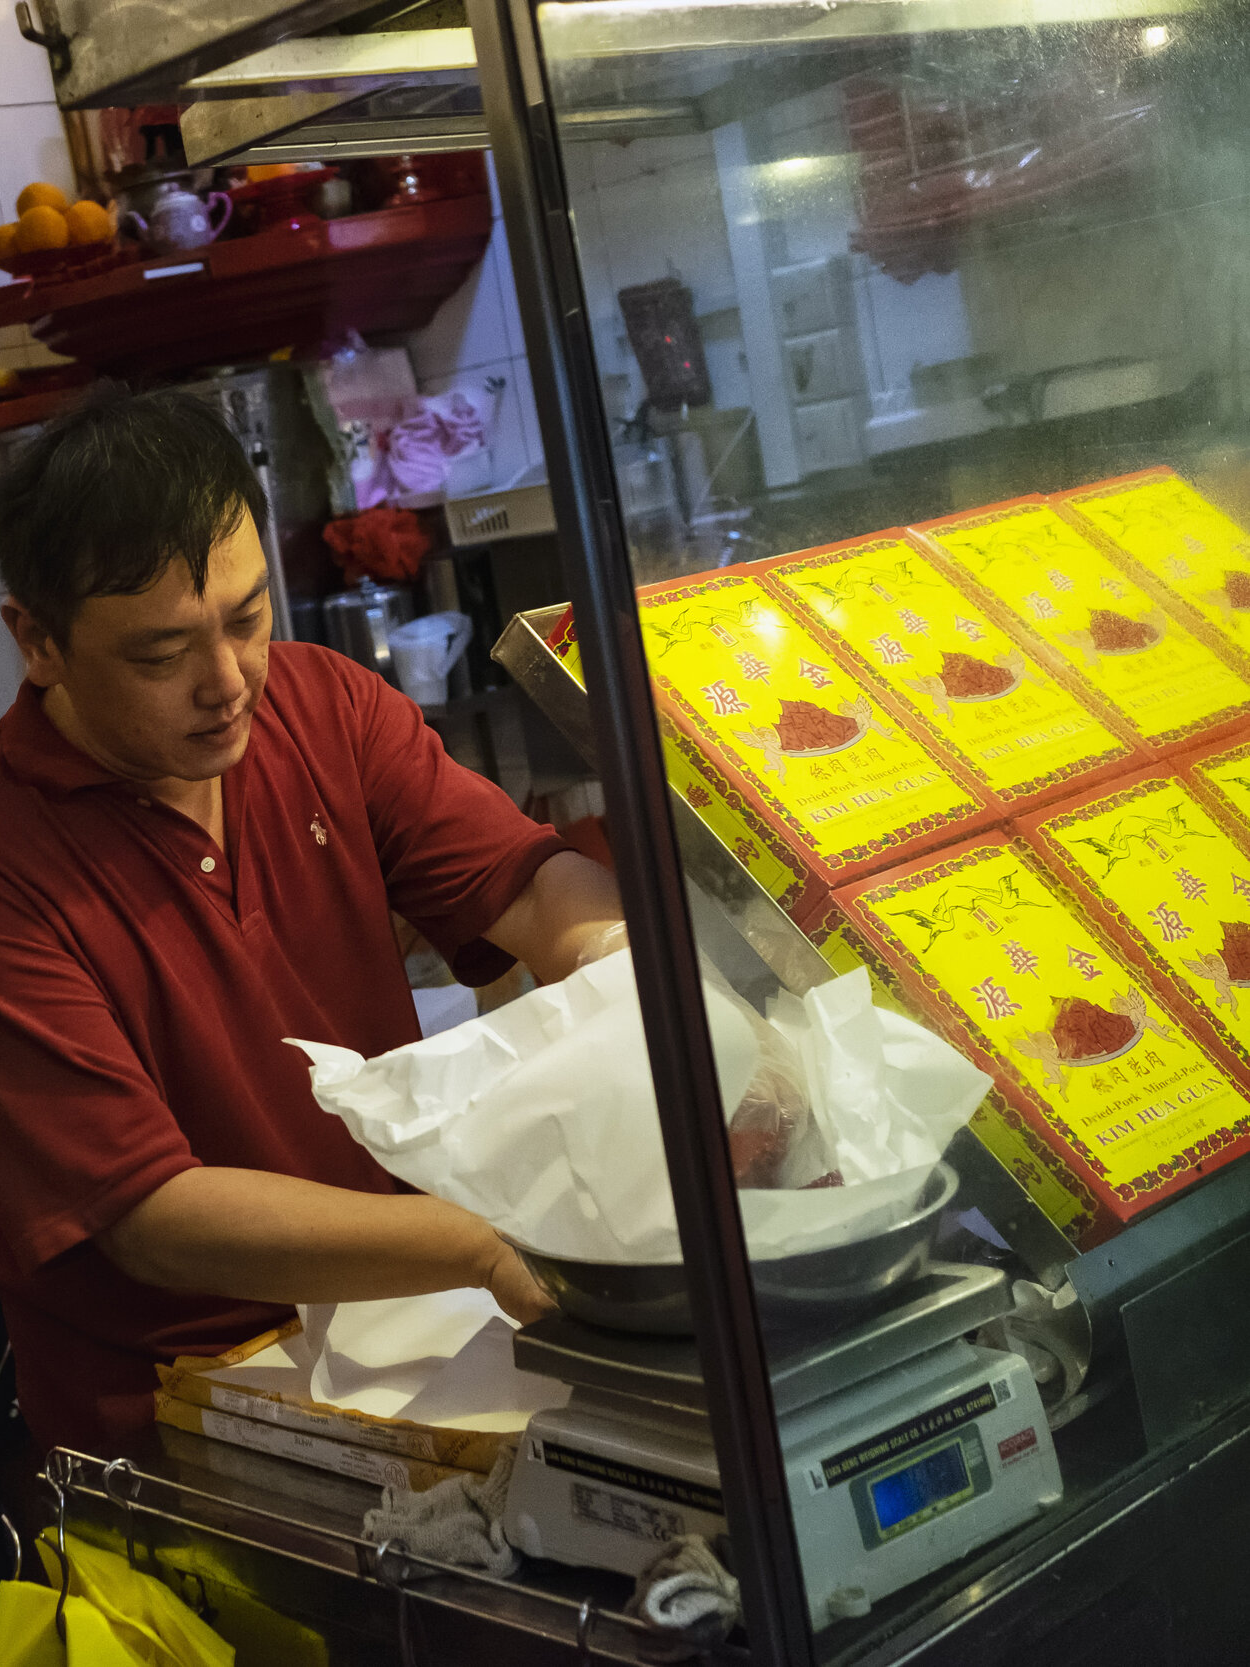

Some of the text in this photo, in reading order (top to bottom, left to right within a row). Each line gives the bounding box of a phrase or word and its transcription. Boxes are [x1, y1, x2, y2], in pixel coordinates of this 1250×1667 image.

[796, 756, 927, 808] Dried-Pork Minced-Pork
[809, 769, 943, 825] KIM HUA GUAN
[1080, 1061, 1207, 1128] Dried-Pork Minced-Pork
[1095, 1119, 1137, 1147] KIM
[1136, 1099, 1178, 1126] HUA
[1177, 1075, 1224, 1105] GUAN
